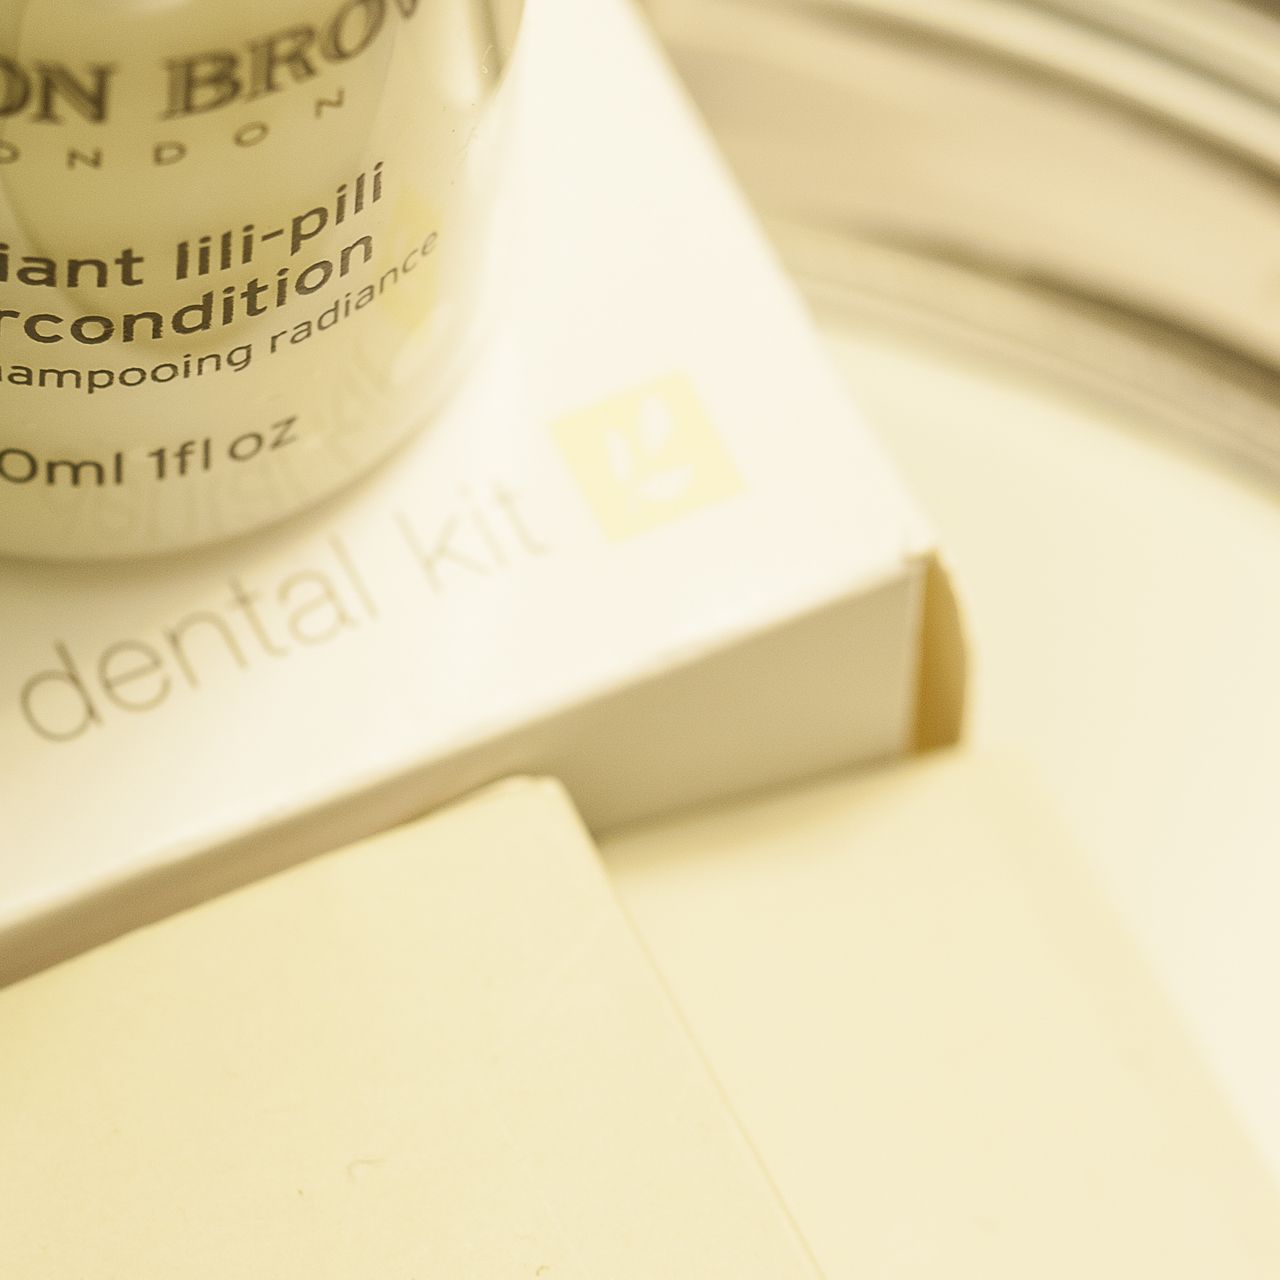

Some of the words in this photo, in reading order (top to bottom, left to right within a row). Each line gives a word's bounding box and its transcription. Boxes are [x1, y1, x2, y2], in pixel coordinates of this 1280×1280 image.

[176, 161, 384, 280] lili-pili
[270, 230, 438, 354] radiance
[228, 415, 299, 462] oz
[18, 532, 381, 744] dental
[400, 483, 552, 594] kit
